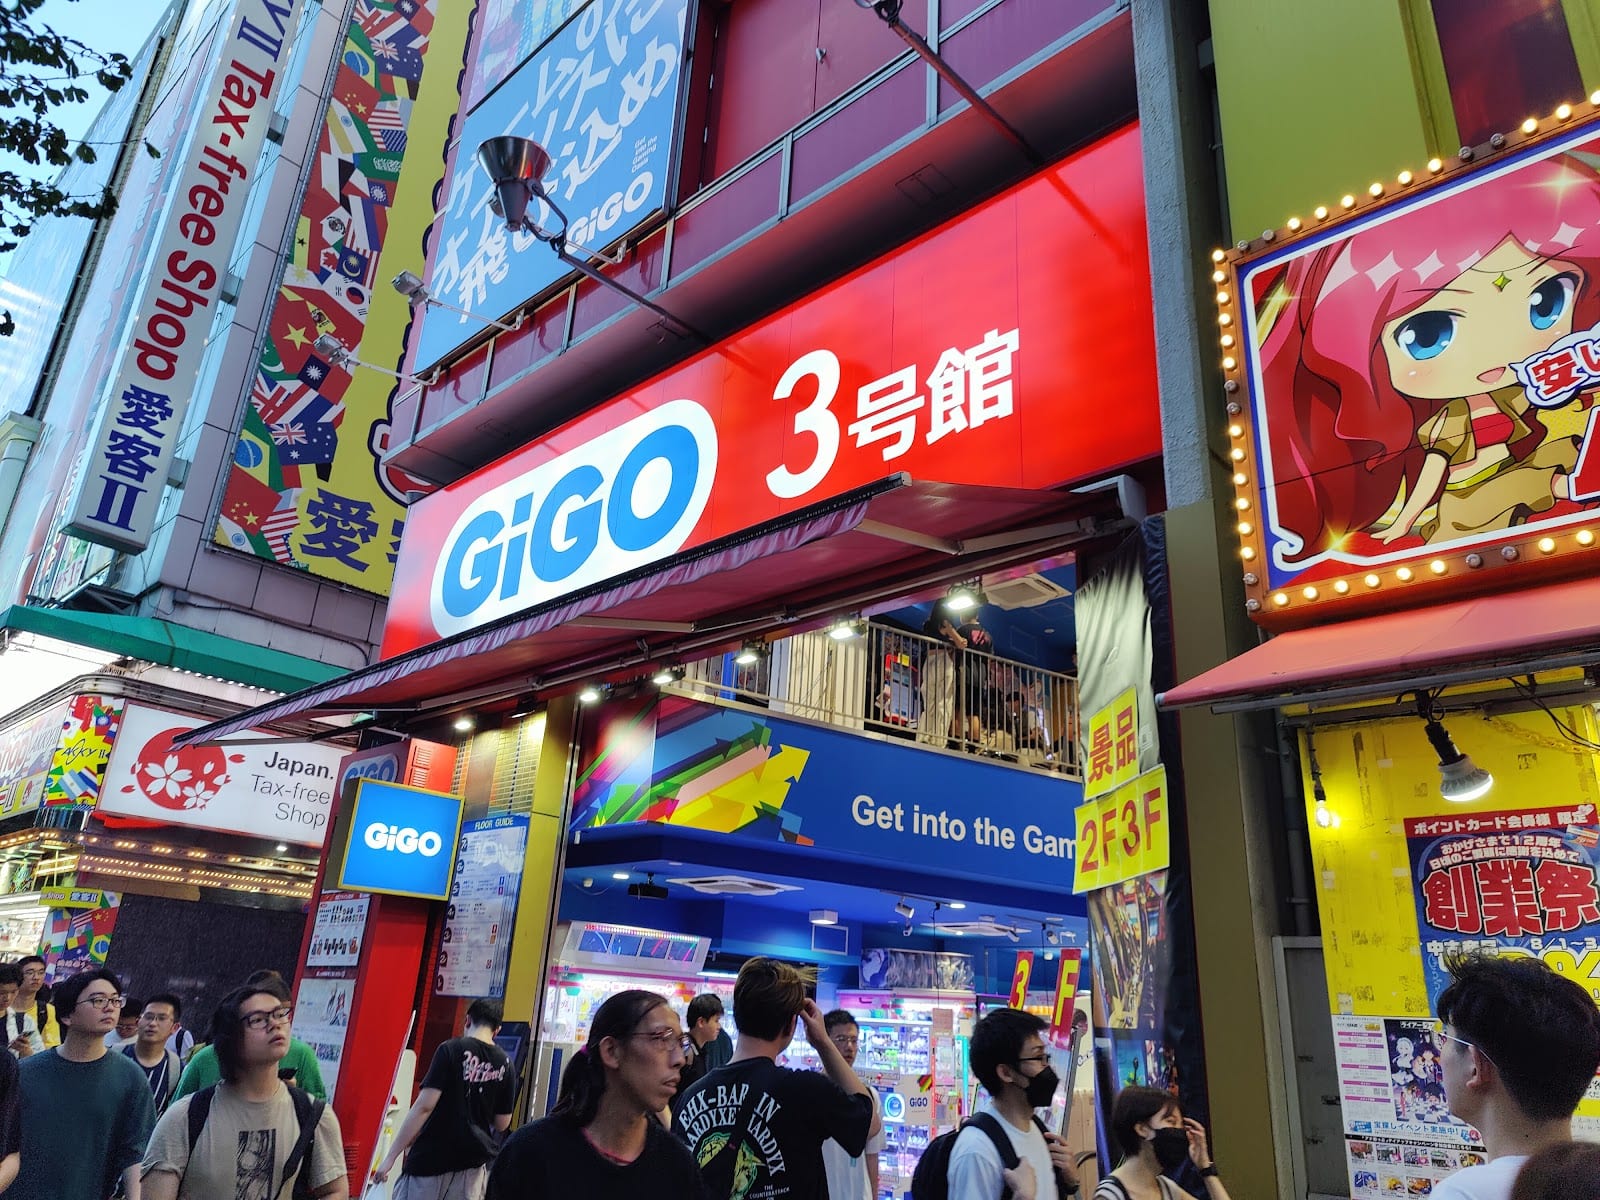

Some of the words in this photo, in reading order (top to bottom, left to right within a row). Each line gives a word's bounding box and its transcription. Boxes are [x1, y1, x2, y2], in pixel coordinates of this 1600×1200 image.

[180, 59, 276, 247] Tax-free
[564, 171, 653, 255] GiGO
[135, 251, 217, 381] Shop
[765, 327, 1020, 499] 3号館
[441, 424, 700, 618] GiGO
[264, 751, 334, 780] Japan.
[1088, 705, 1138, 784] 景品
[251, 773, 331, 805] Tax-free
[275, 802, 326, 830] Shop
[474, 820, 493, 831] FLOOR
[495, 817, 514, 827] GUIDE
[852, 795, 905, 832] Get
[913, 804, 967, 842] into
[974, 817, 1015, 850] the
[1414, 813, 1551, 835] ポイントカード会員様
[1557, 810, 1588, 825] 限定
[364, 822, 442, 857] GiGO
[1422, 858, 1600, 937] 創業祭
[754, 1091, 781, 1123] IN
[910, 1097, 928, 1107] GiGO
